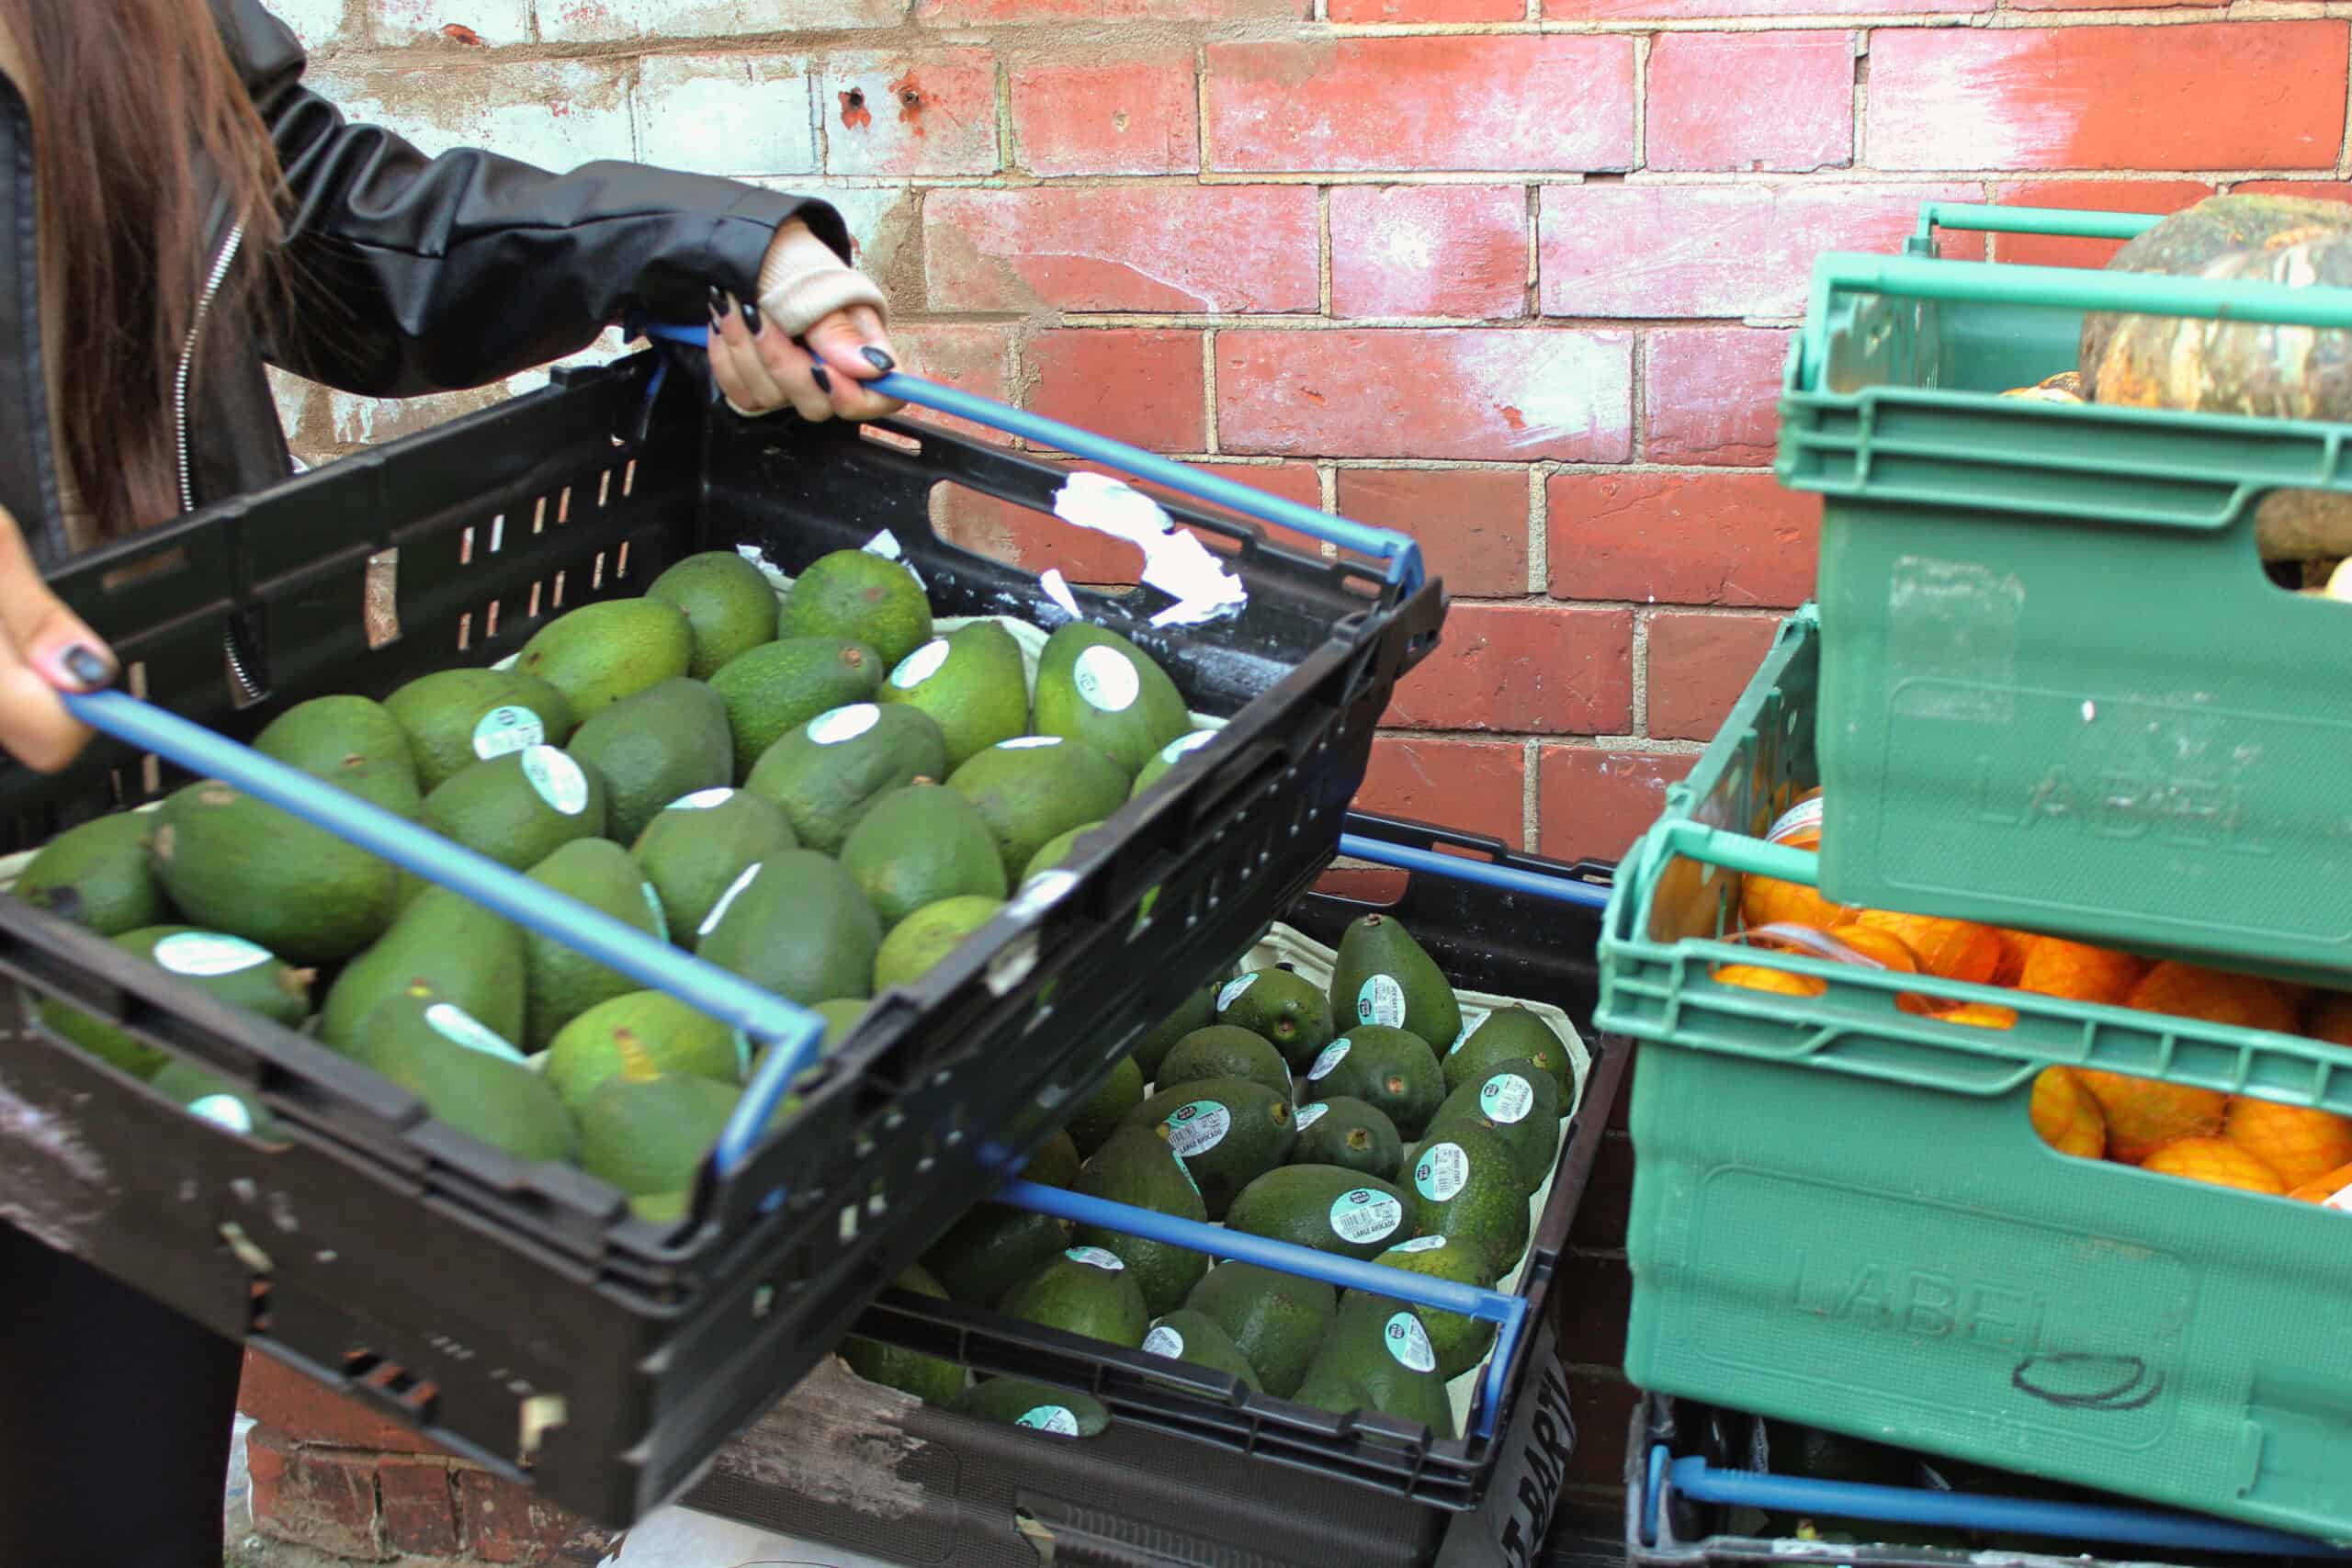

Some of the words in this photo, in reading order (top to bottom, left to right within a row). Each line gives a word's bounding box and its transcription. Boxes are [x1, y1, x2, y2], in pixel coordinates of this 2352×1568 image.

[1181, 1140, 1198, 1154] LARGE
[1197, 1129, 1221, 1145] AVOCADO
[1353, 1227, 1370, 1238] LARGE
[1372, 1219, 1396, 1231] AVOCADO
[1788, 1249, 2069, 1359] LABEL
